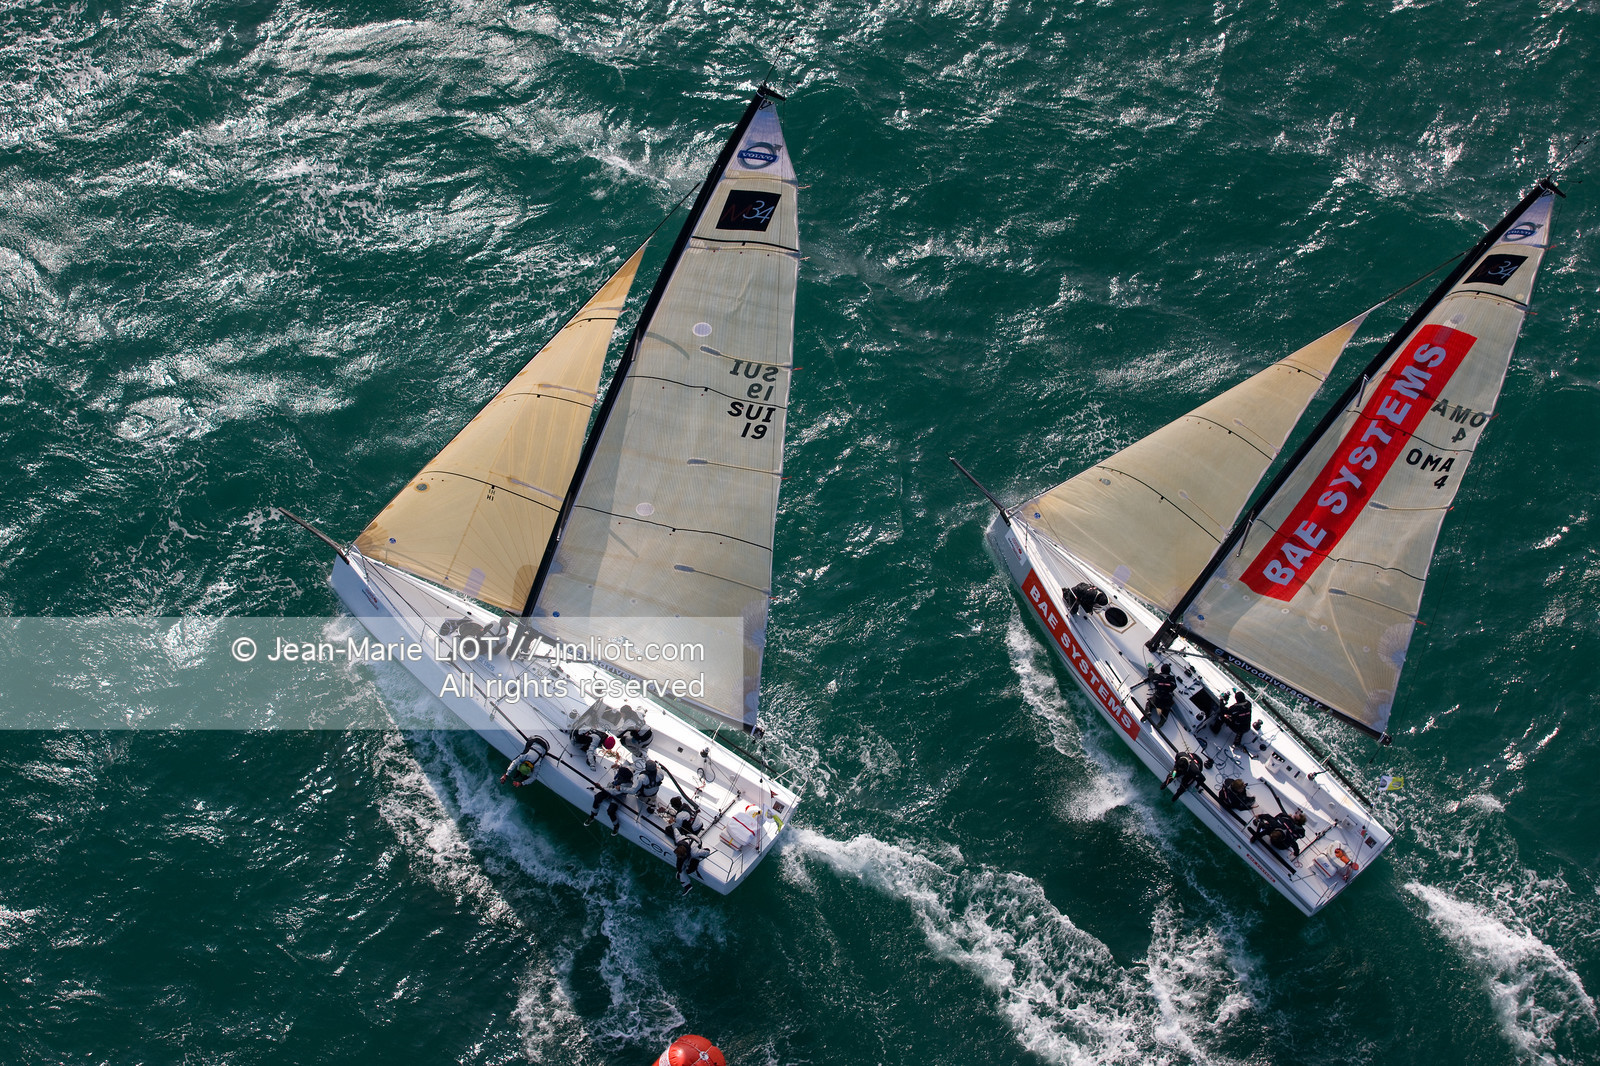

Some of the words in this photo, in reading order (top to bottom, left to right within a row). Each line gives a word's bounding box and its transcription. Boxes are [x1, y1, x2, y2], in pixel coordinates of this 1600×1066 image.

[742, 152, 774, 161] VOLVO
[727, 401, 777, 423] SUI
[741, 422, 768, 440] 19
[1262, 520, 1327, 586] BAE
[1317, 343, 1447, 514] SYSTEMS
[1405, 448, 1456, 472] OMA
[1433, 475, 1449, 490] 4
[1029, 585, 1059, 630] BAE
[1060, 632, 1132, 729] SYSTEMS
